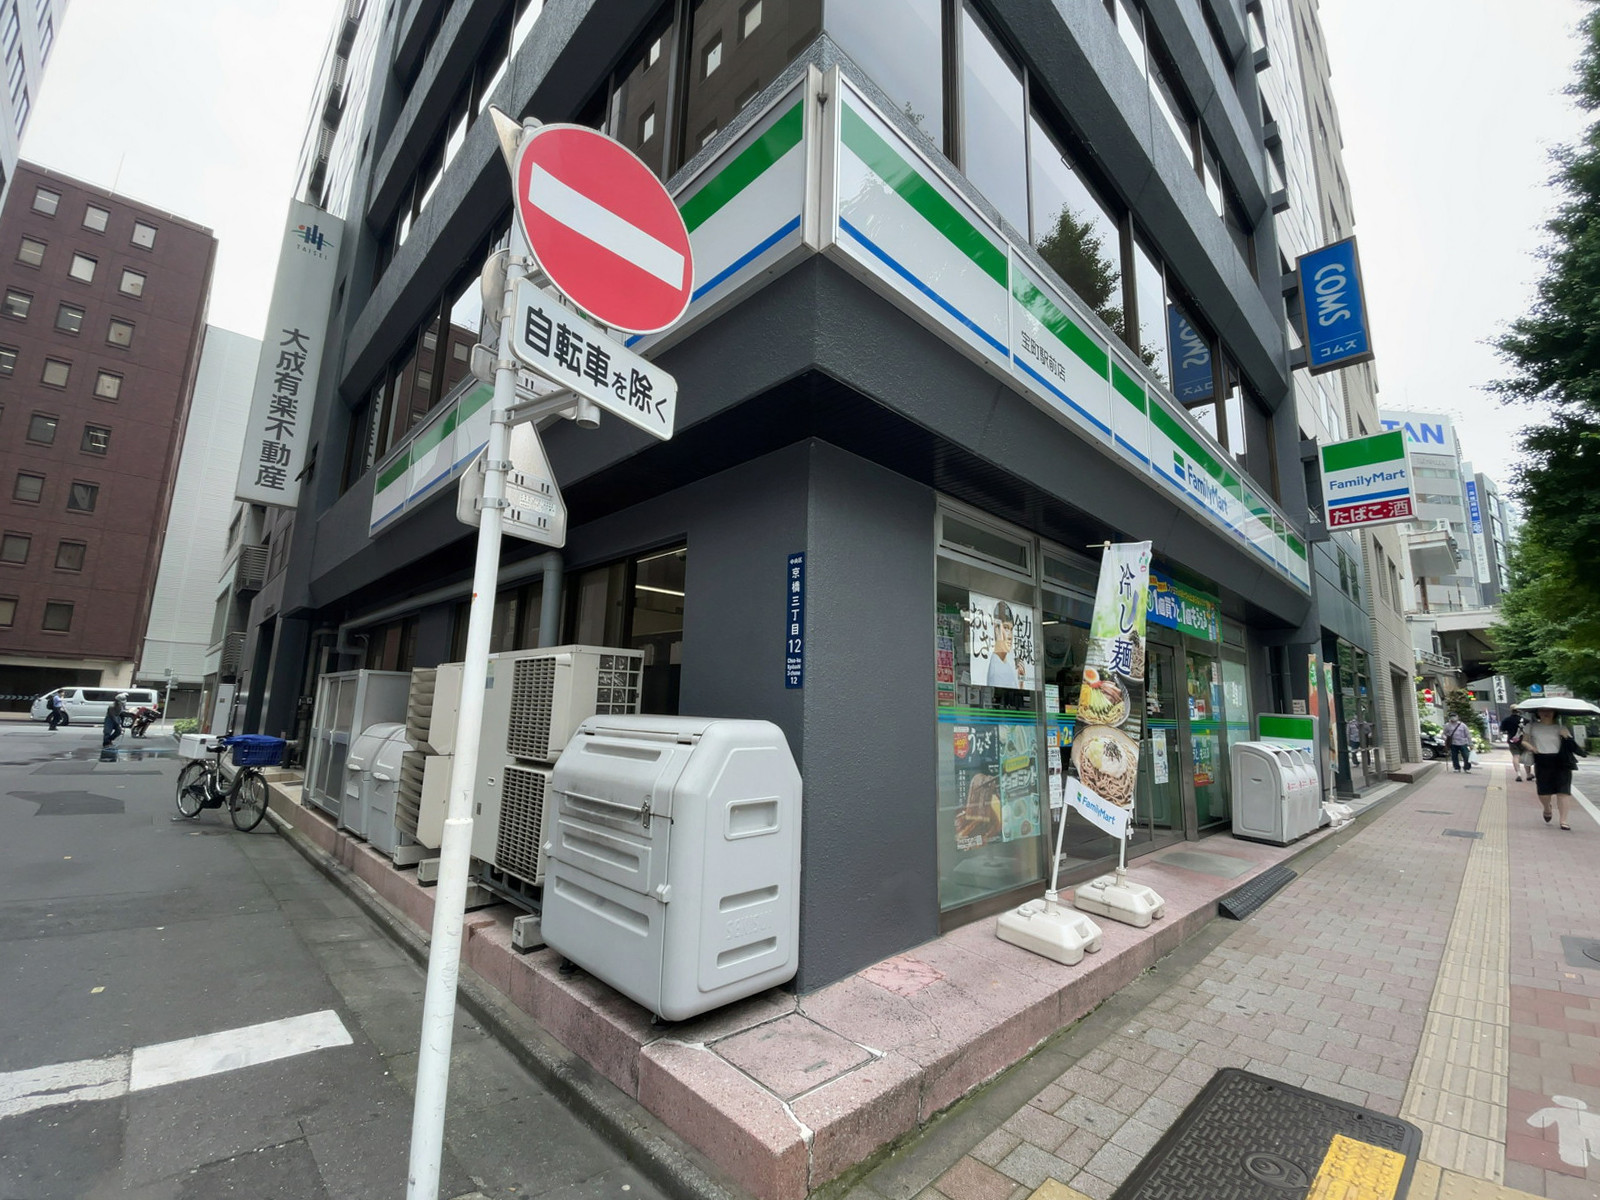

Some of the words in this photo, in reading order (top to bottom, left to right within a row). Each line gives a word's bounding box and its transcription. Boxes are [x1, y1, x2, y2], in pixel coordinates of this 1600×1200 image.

[296, 244, 329, 260] TAISEI
[1314, 263, 1350, 327] COMS
[1320, 339, 1357, 358] コムス
[524, 304, 668, 425] 自転車を除く
[254, 328, 311, 491] 大成有楽不動産
[1187, 463, 1229, 516] FamilyMart
[1329, 468, 1406, 491] FamilyMart
[1332, 501, 1410, 526] たばこ・酒
[1108, 563, 1137, 676] 冷し麺
[788, 638, 802, 653] 12
[790, 676, 798, 685] 12
[1081, 795, 1117, 826] FamilyMart
